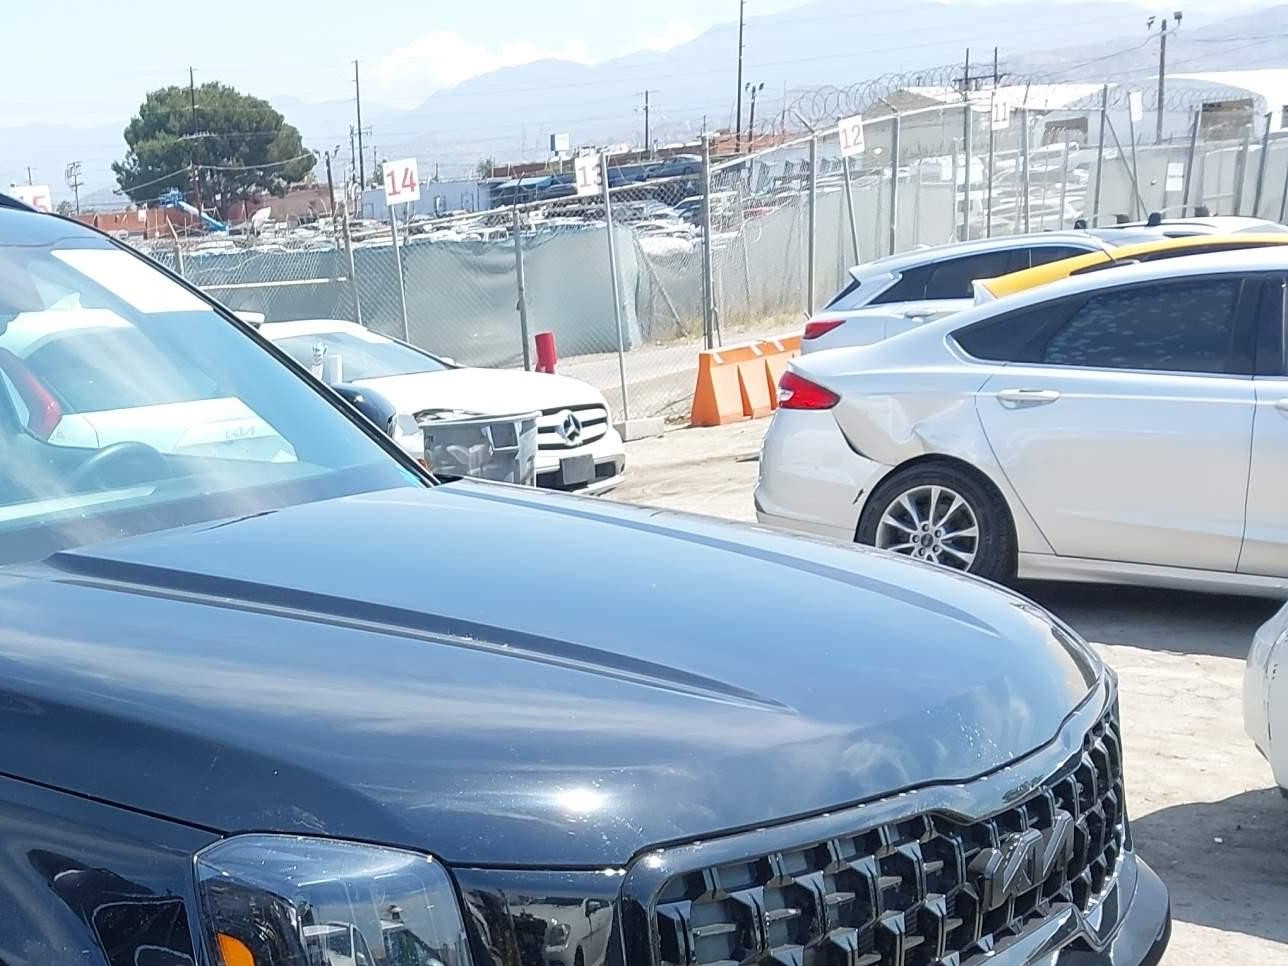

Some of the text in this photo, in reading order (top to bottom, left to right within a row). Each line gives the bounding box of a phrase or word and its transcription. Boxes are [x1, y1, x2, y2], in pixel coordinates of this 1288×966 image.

[993, 102, 1009, 122] 11
[842, 125, 863, 149] 12
[386, 167, 417, 196] 14
